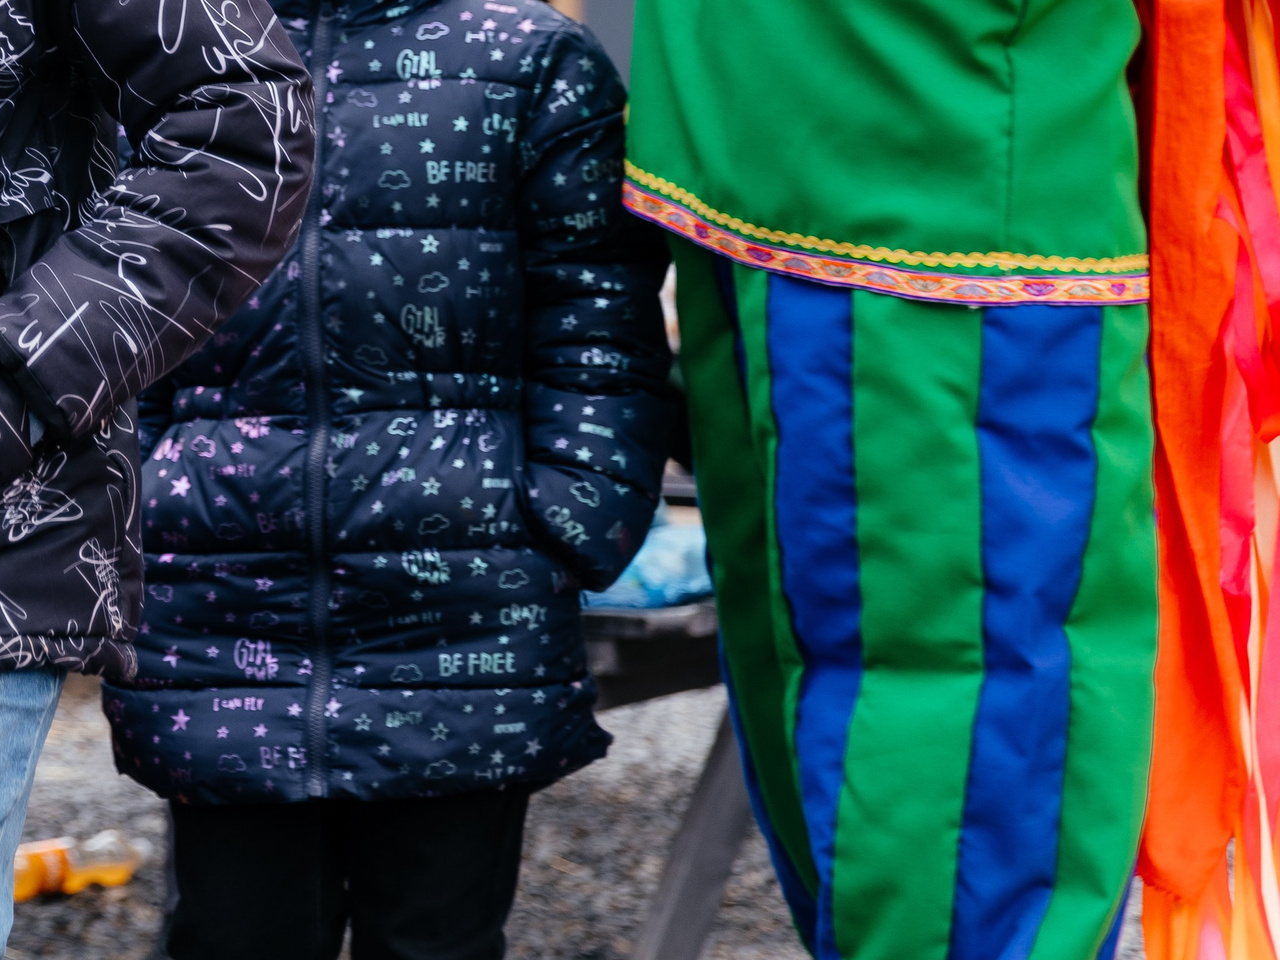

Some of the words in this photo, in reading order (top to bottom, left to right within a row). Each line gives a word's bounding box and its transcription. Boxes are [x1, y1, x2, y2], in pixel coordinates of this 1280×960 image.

[396, 48, 442, 80] GIRL
[407, 112, 429, 127] FLY
[425, 160, 451, 184] BE
[400, 304, 445, 334] GIRL
[499, 603, 548, 631] CRAZY
[233, 638, 279, 670] GIRL
[438, 652, 464, 678] BE
[467, 651, 517, 676] FREE
[244, 696, 265, 712] FLY
